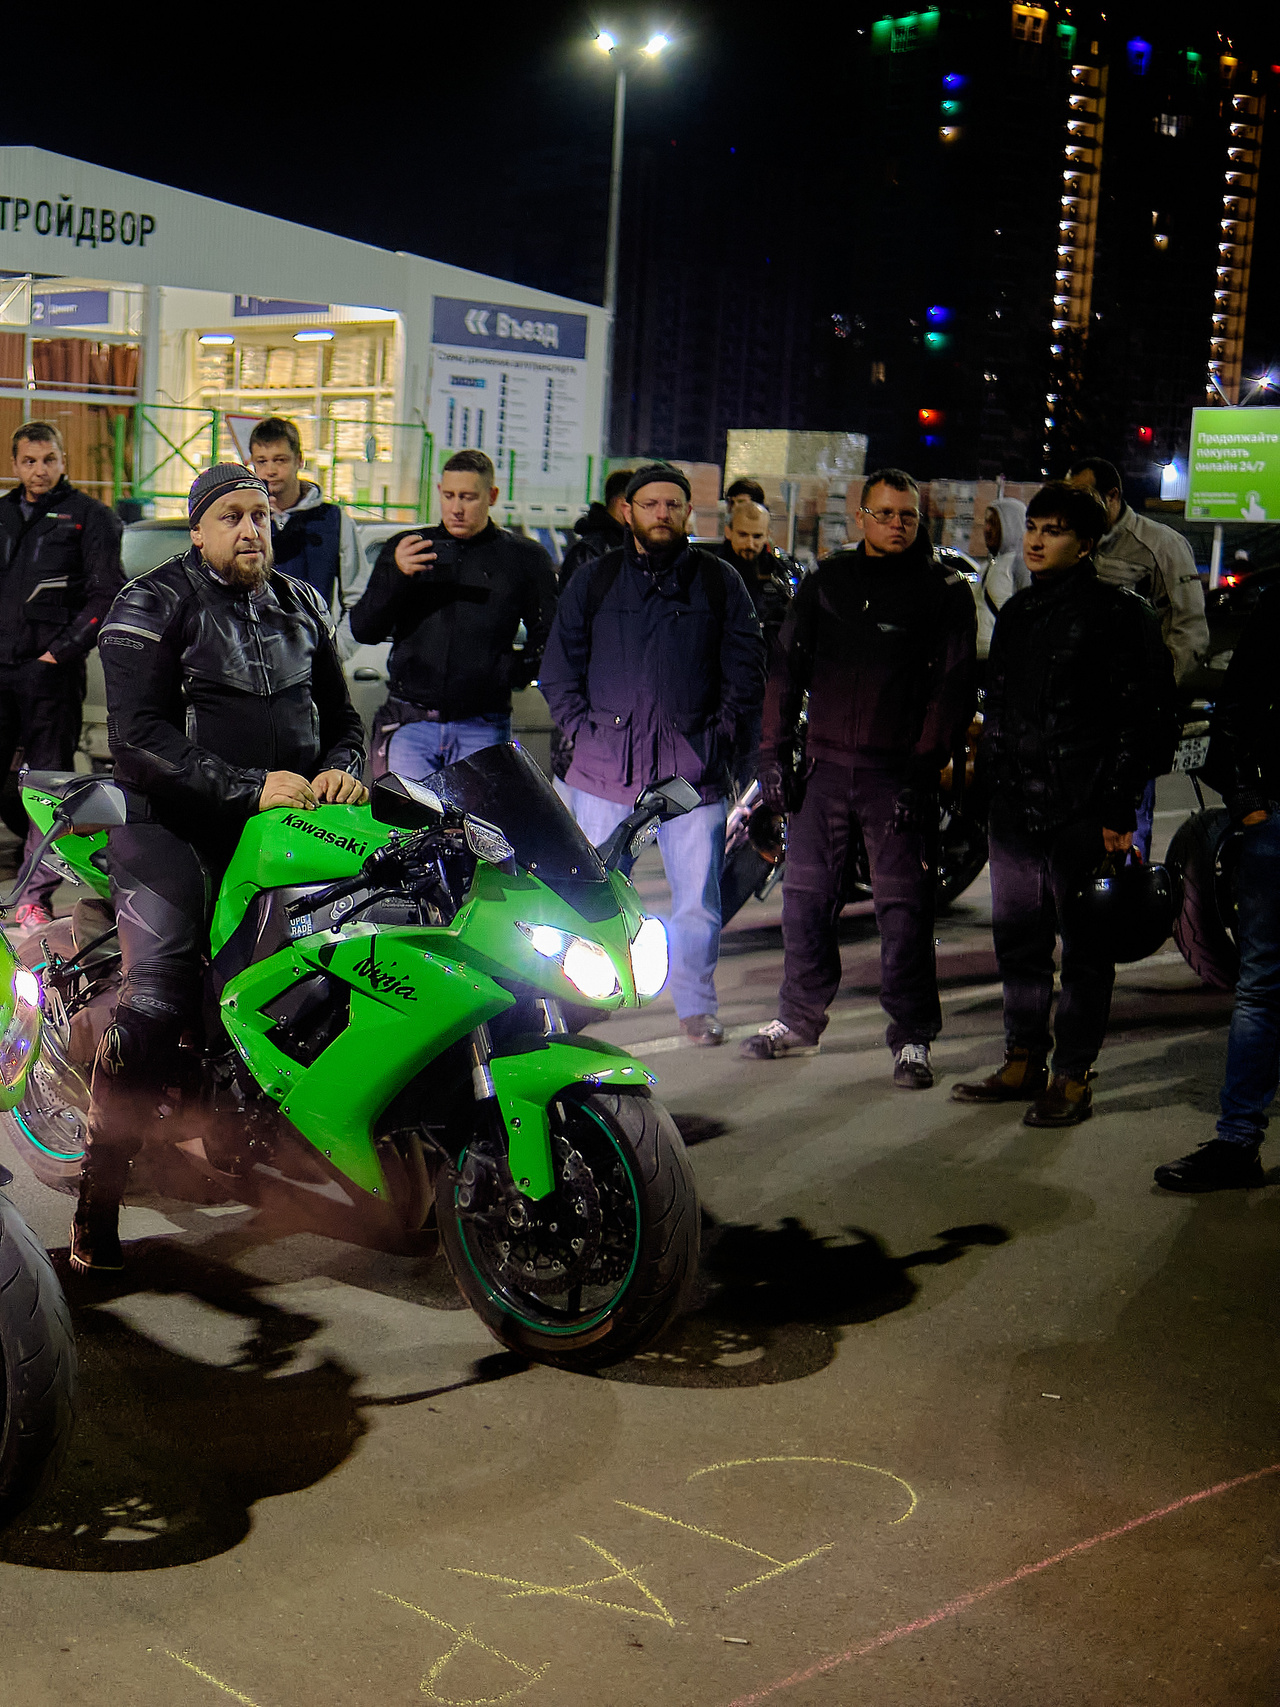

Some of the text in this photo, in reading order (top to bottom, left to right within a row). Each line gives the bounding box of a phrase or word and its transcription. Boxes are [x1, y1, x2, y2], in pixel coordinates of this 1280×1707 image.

[32, 301, 45, 320] 2
[495, 312, 559, 349] Въезд
[1198, 432, 1279, 446] Продолжайте
[1197, 448, 1250, 460] покупать
[1195, 461, 1266, 473] онлайн 24/7
[281, 813, 368, 857] Kawasaki
[289, 915, 307, 926] UPG
[291, 923, 313, 936] RADE
[352, 957, 418, 1002] Ninja
